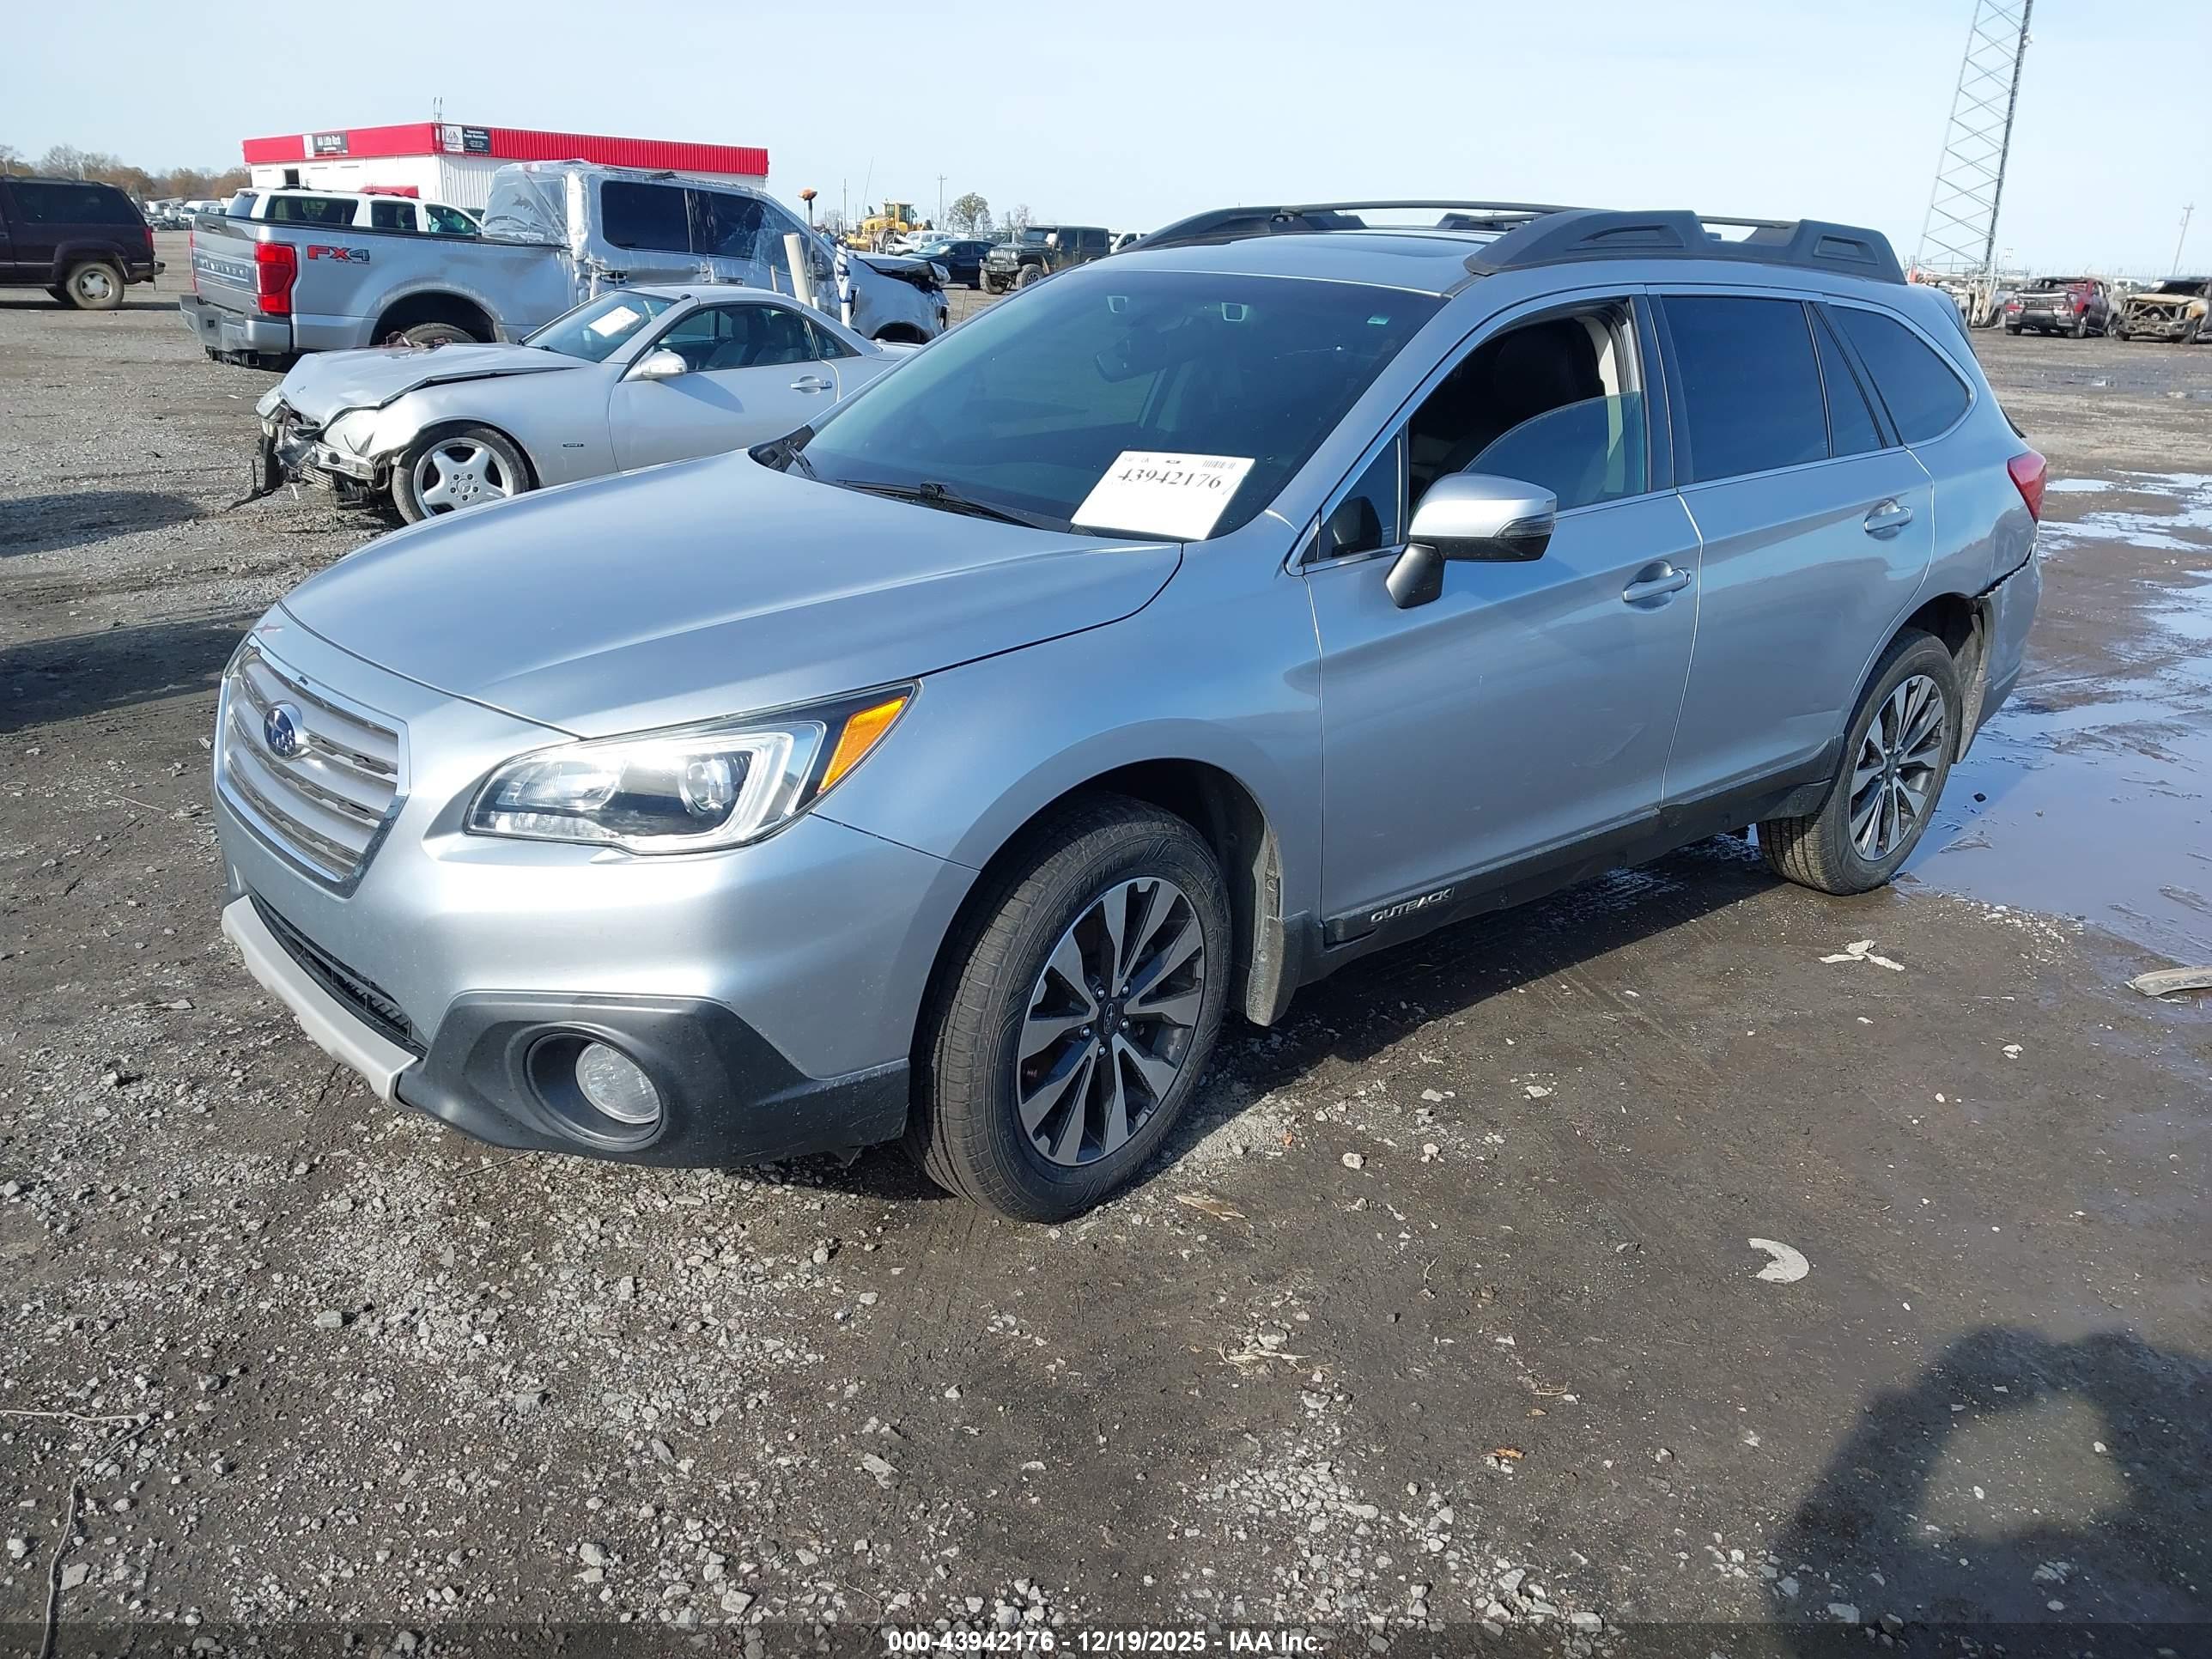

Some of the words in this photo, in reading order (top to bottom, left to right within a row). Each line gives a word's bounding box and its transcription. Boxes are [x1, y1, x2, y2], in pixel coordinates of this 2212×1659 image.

[307, 245, 370, 261] FX4
[1118, 468, 1222, 489] 43942176
[1370, 887, 1455, 922] OUTBACK
